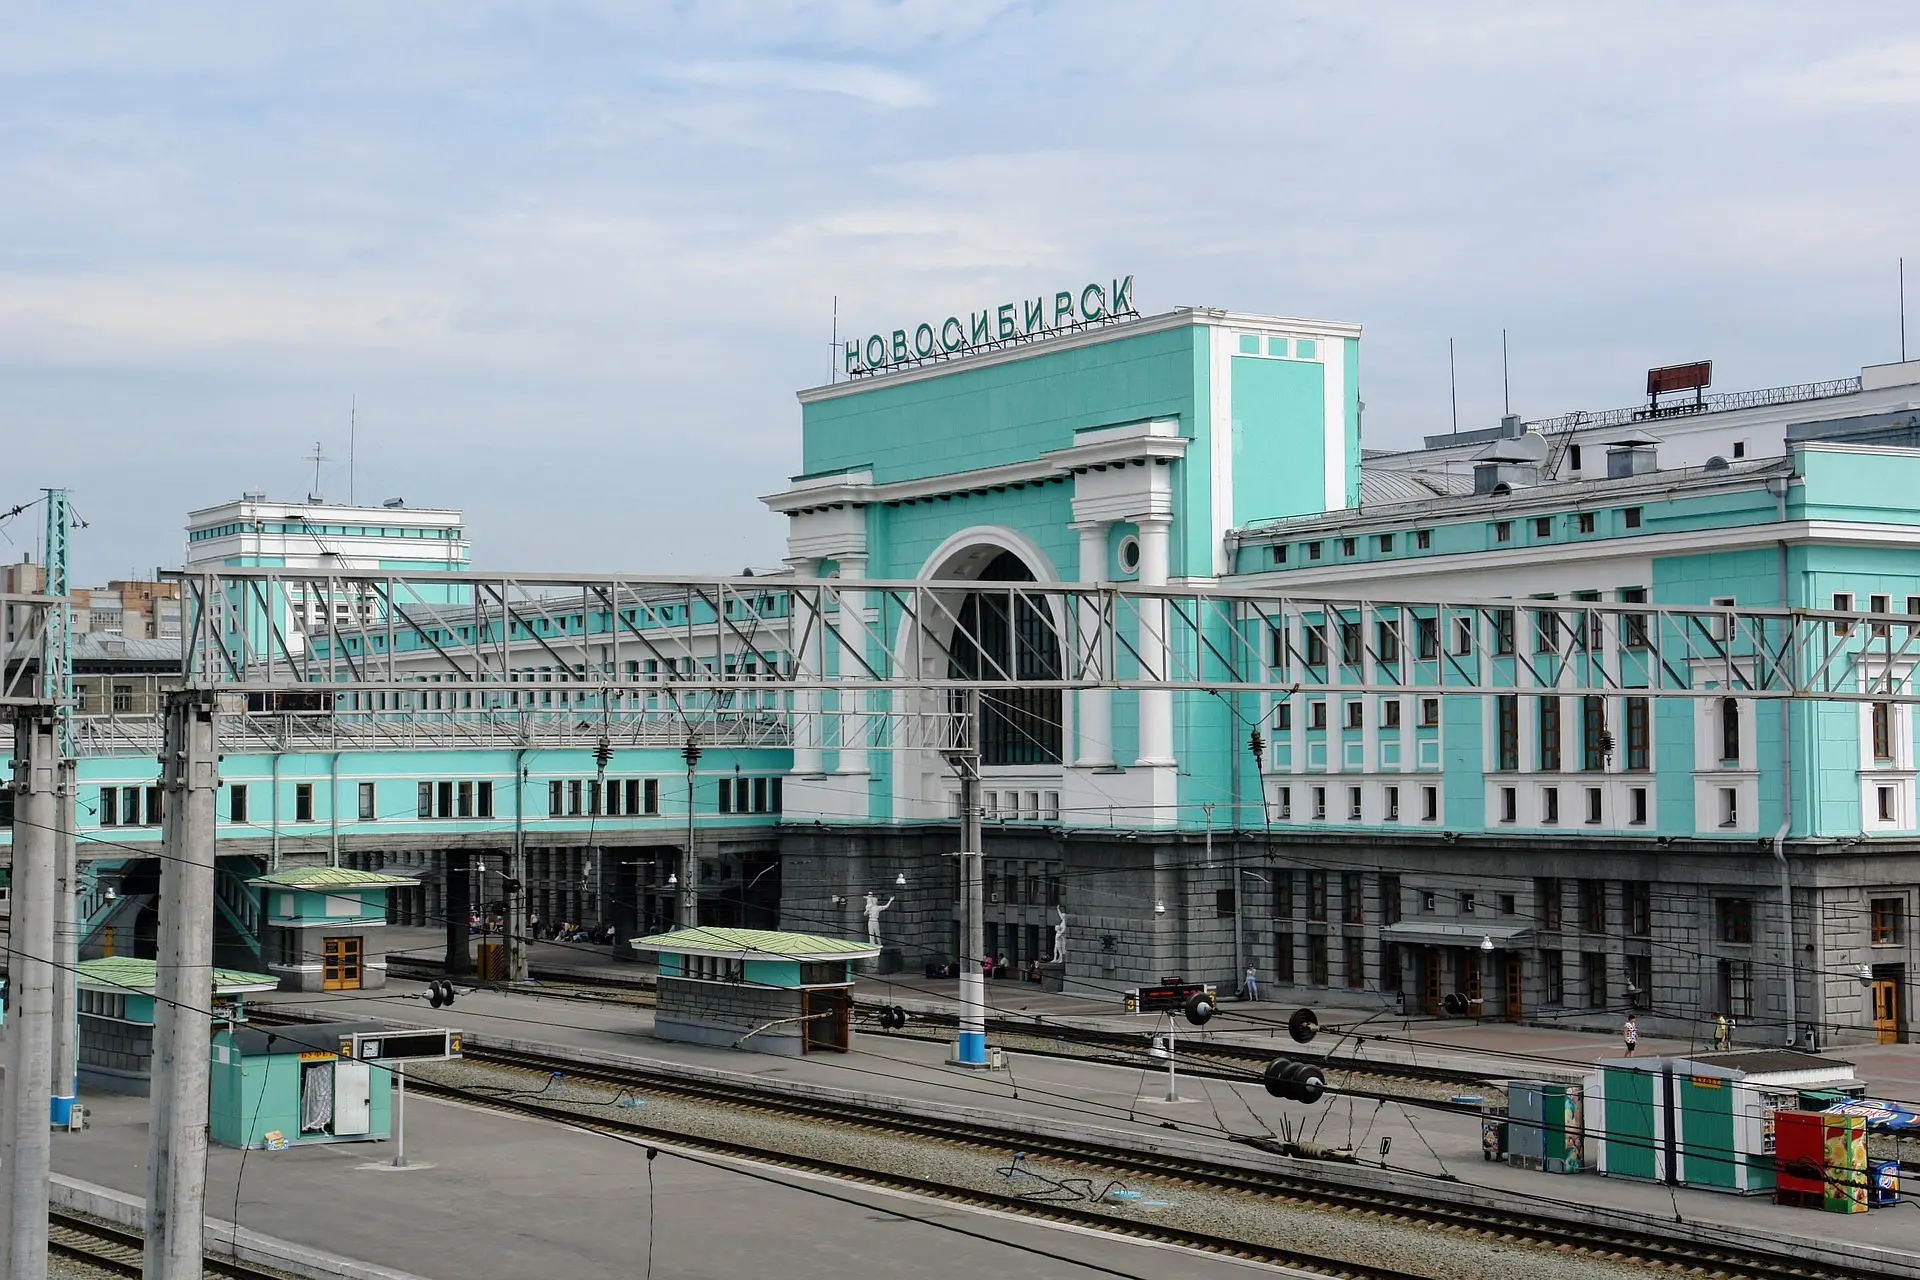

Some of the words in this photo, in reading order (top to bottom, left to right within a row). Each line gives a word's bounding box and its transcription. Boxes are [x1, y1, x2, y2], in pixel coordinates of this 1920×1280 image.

[846, 274, 1135, 373] НОВОСИБИРСК
[451, 1040, 461, 1051] 4
[342, 1046, 350, 1057] 5
